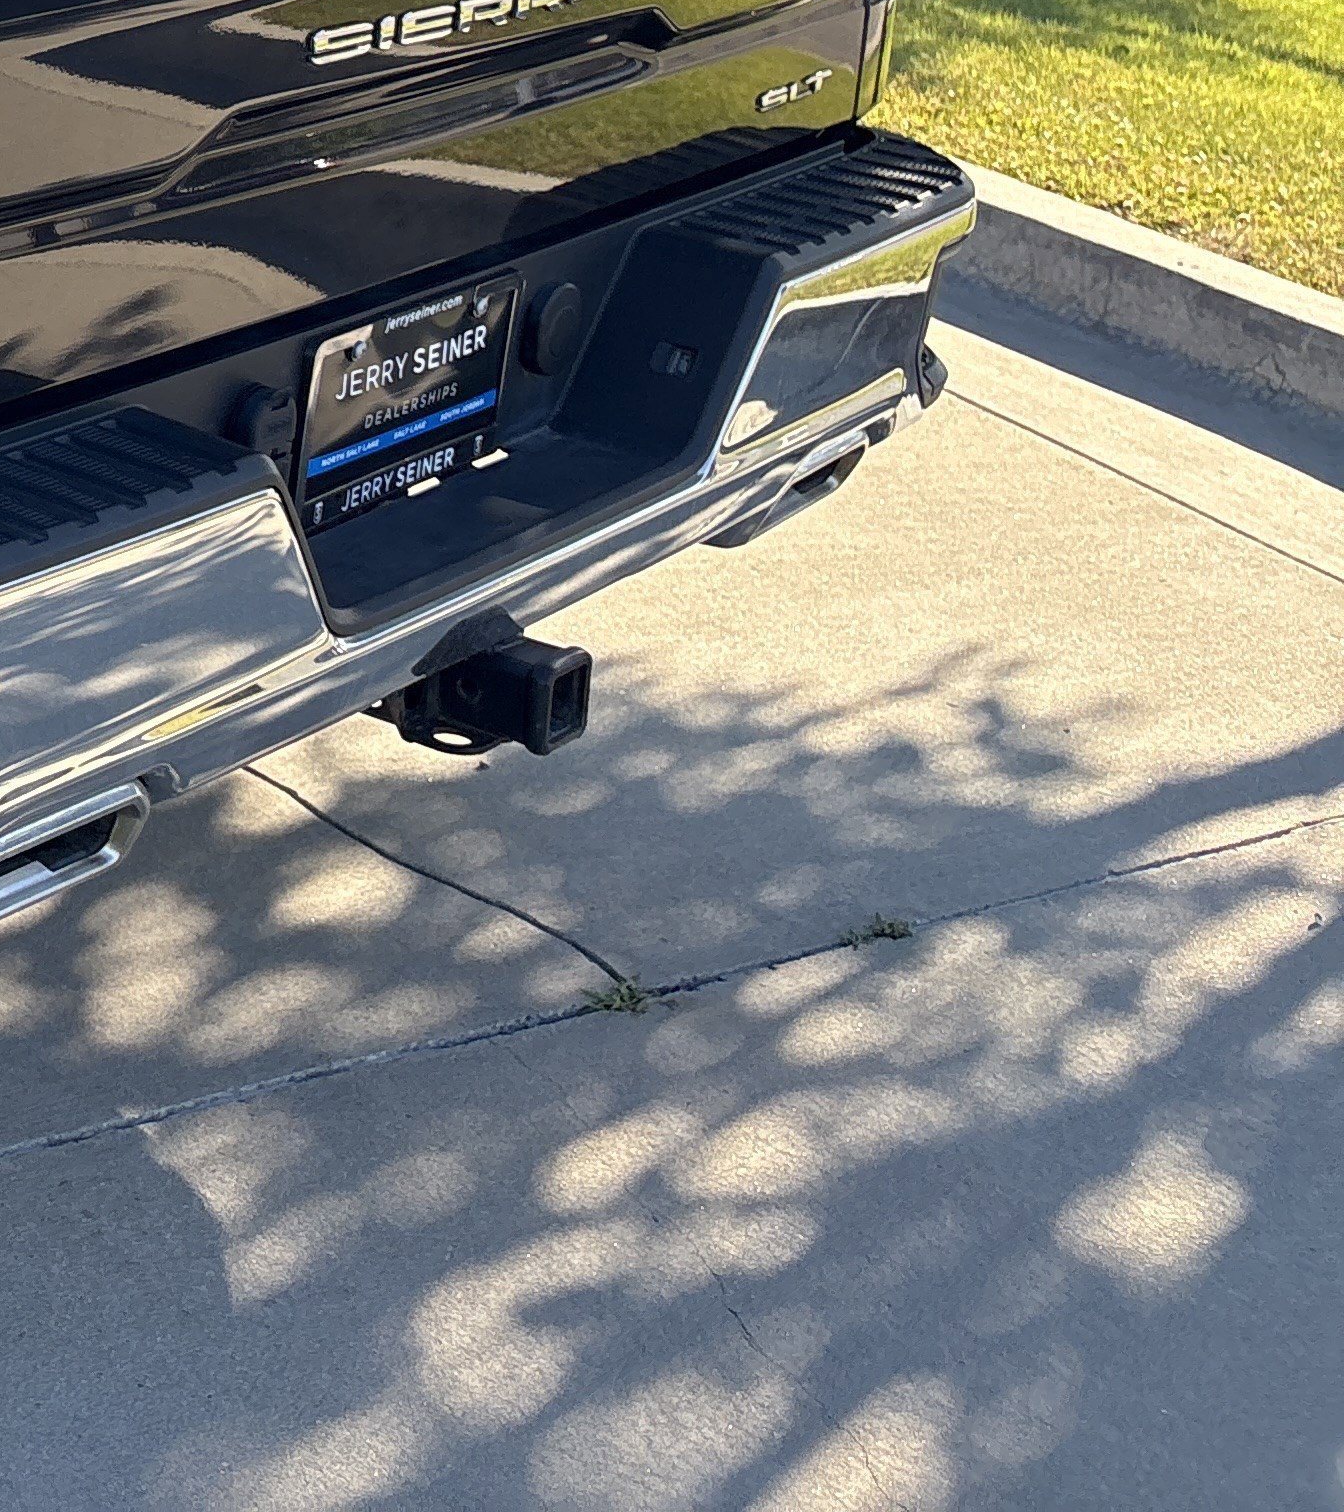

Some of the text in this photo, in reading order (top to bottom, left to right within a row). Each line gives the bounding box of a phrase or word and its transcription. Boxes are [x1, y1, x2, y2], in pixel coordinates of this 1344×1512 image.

[755, 68, 833, 113] SLT
[384, 294, 464, 334] jerryseiner.com
[335, 324, 487, 401] JERRY SEINER
[364, 382, 459, 430] DEALERSHIPS
[340, 447, 455, 512] JERRY SEINER
